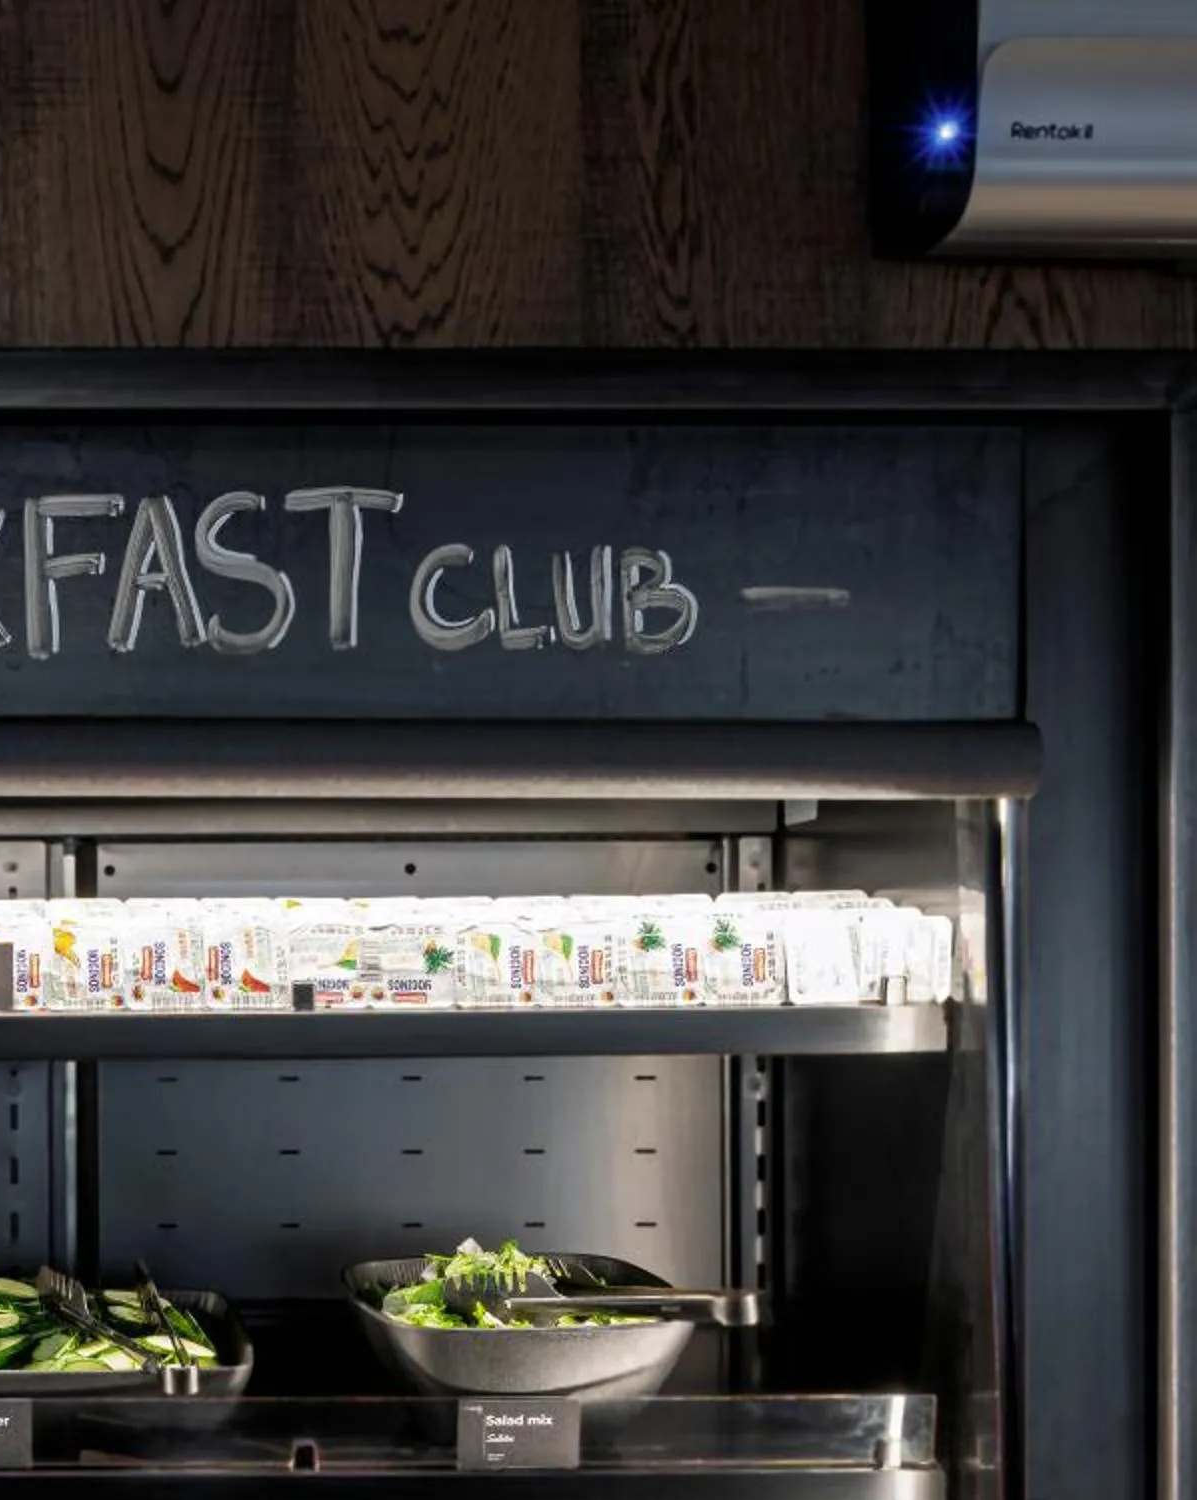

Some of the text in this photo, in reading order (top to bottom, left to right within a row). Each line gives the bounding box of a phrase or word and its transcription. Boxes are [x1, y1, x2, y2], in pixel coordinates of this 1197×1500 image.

[1010, 121, 1094, 140] Rentokil
[408, 542, 699, 655] CLUB
[485, 1413, 553, 1426] Salad mix
